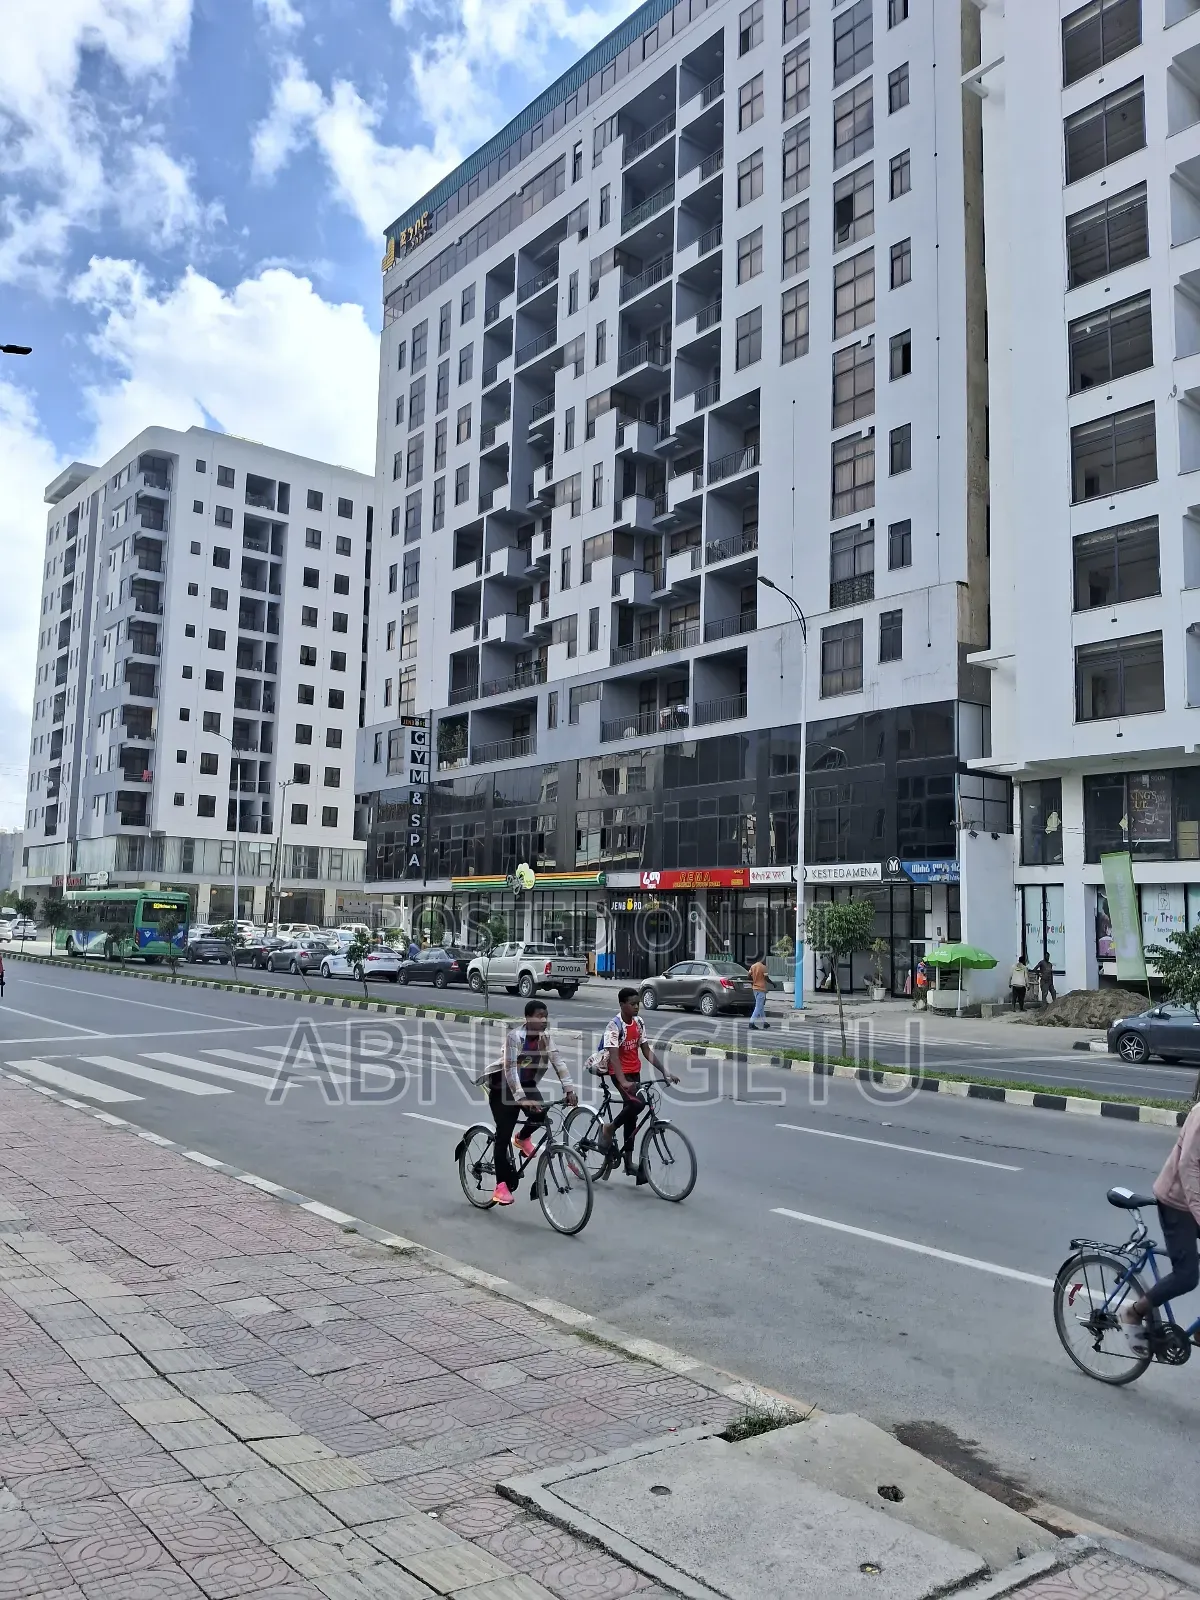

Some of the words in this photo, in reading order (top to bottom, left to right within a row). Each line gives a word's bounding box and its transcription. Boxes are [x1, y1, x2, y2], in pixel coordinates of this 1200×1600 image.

[412, 731, 425, 783] GYM
[412, 792, 422, 805] &
[408, 813, 421, 867] SPA
[811, 867, 880, 879] KESTEDAMENA
